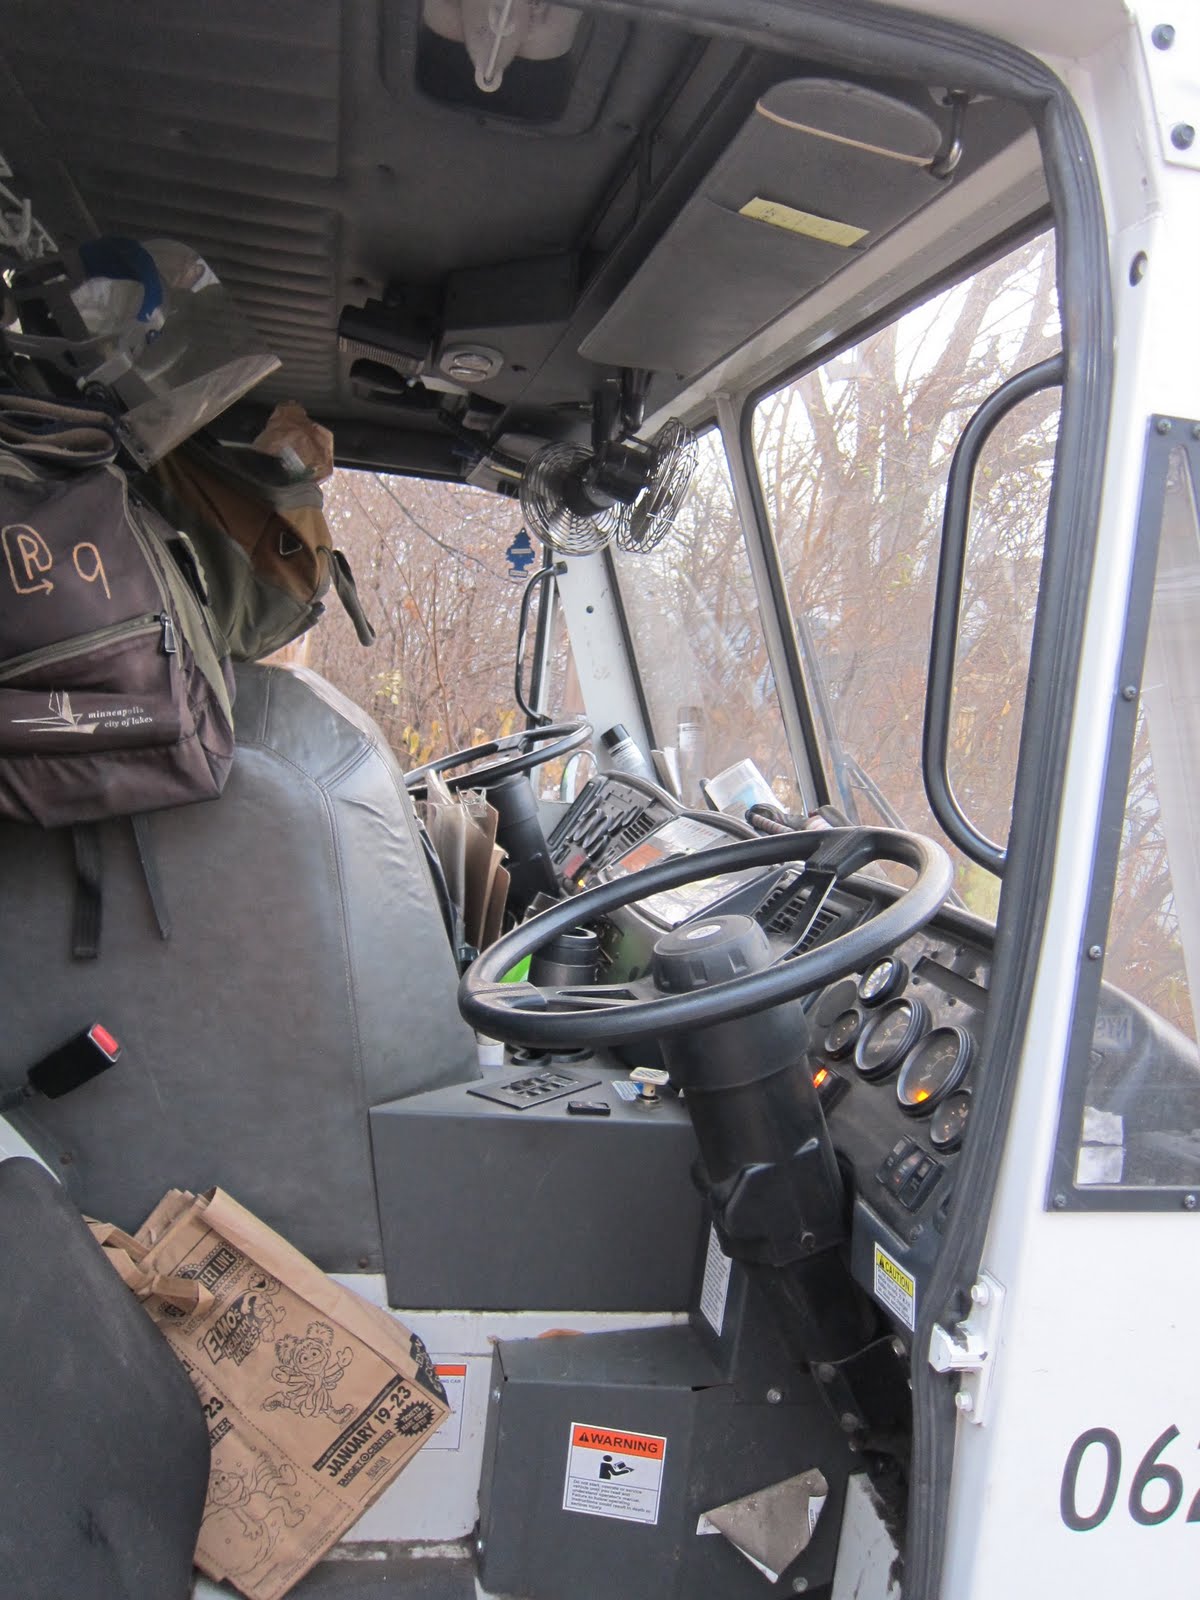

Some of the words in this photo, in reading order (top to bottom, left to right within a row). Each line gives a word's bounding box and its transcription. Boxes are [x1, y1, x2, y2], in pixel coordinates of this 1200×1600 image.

[88, 706, 144, 719] minneapolis
[104, 720, 119, 728] city
[121, 717, 131, 728] of
[131, 716, 153, 725] lakes
[200, 1267, 219, 1288] EET
[216, 1250, 234, 1271] LIVE
[884, 1261, 910, 1291] CAUTION
[222, 1315, 251, 1358] HEALTHY
[204, 1396, 224, 1419] -23
[208, 1417, 235, 1441] NTER
[326, 1421, 378, 1478] JANUARY
[373, 1385, 412, 1425] 19-23
[590, 1433, 658, 1454] WARNING
[337, 1460, 364, 1488] TARGET
[367, 1429, 396, 1457] CENTER
